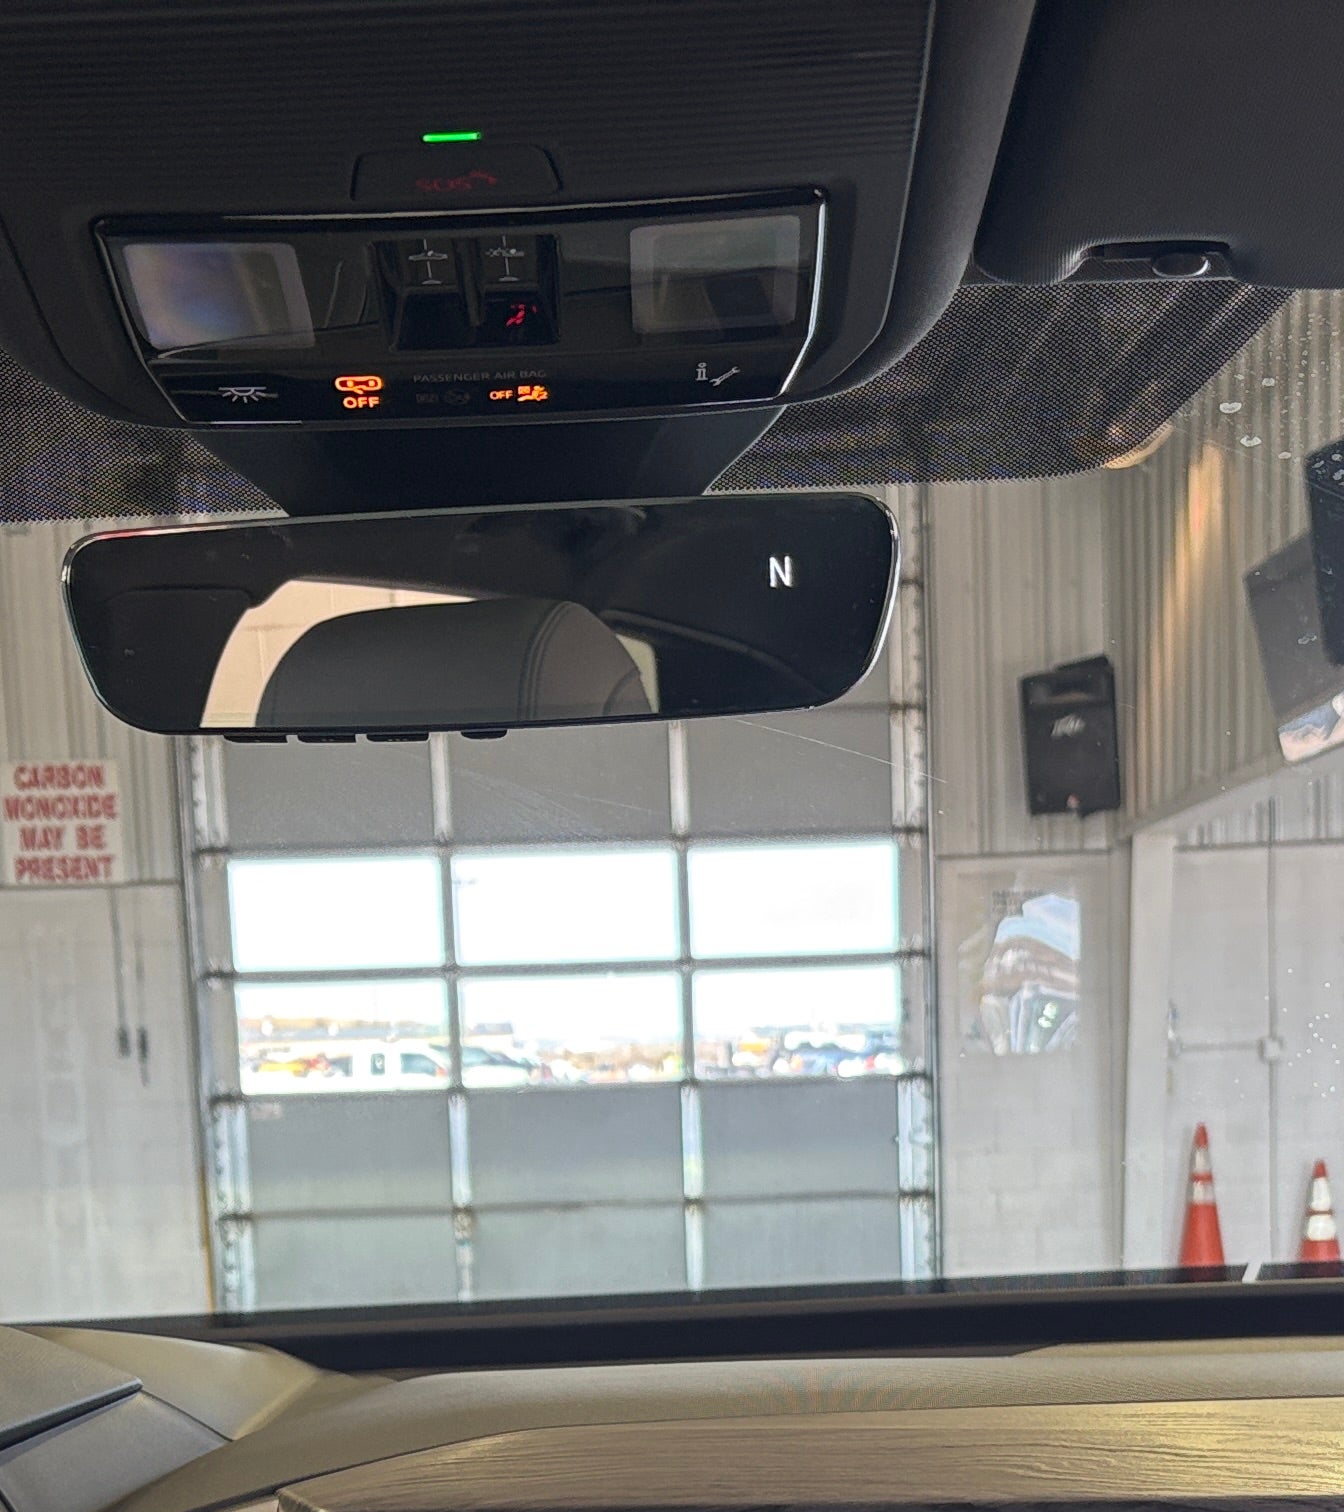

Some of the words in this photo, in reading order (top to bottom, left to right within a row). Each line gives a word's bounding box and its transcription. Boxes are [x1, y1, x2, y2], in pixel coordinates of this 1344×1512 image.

[413, 372, 490, 383] PASSENGER
[494, 370, 517, 380] AIR
[520, 369, 547, 379] BAG
[342, 397, 381, 409] OFF
[489, 390, 514, 401] OFF
[769, 556, 793, 588] N
[14, 764, 104, 790] CARBON
[2, 794, 117, 821] MONOXIDE
[19, 826, 65, 850] MAY
[76, 825, 105, 850] BE
[15, 854, 115, 882] PRESENT
